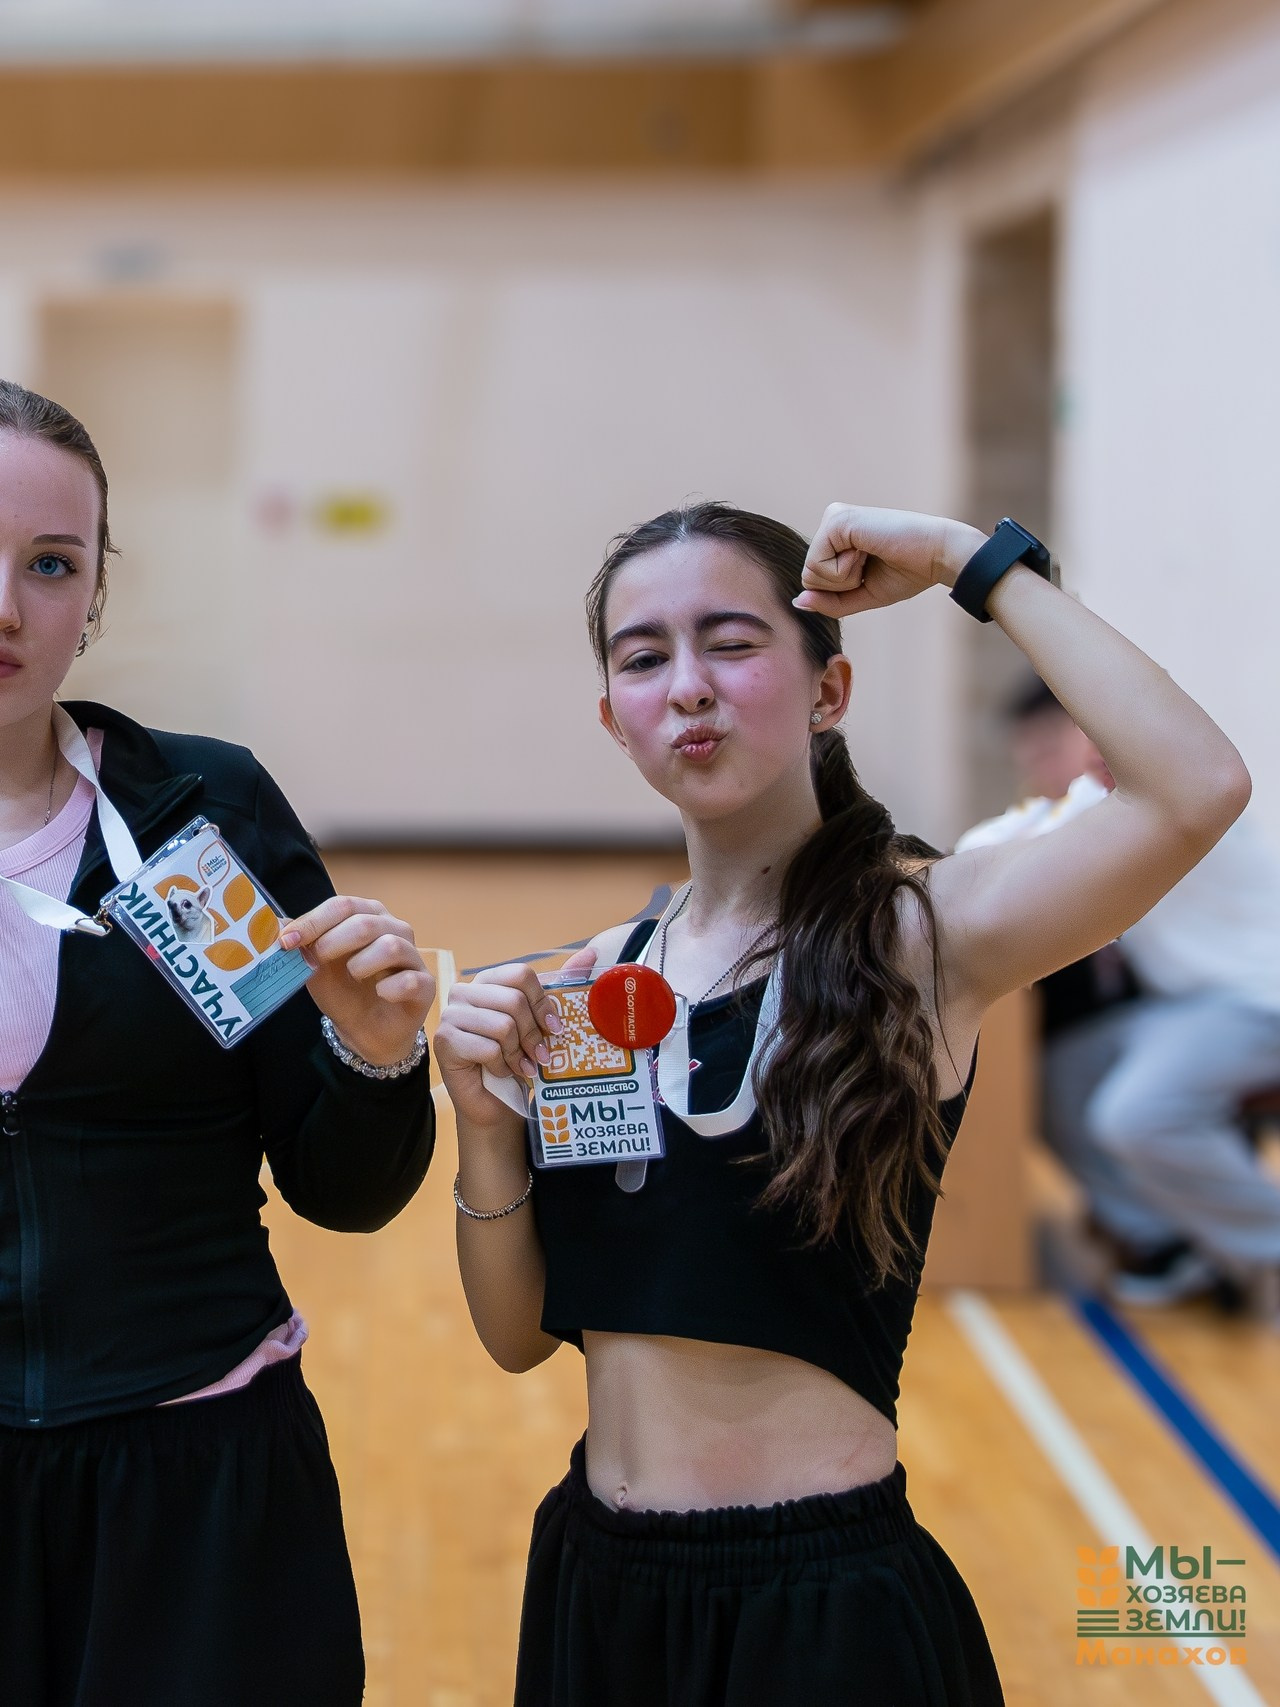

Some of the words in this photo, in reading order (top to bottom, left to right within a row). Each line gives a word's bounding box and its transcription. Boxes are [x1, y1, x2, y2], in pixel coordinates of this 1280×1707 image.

[118, 882, 243, 1039] УЧАСТНИК
[627, 994, 636, 1042] СОГЛАСИЕ
[545, 1088, 573, 1098] НАШЕ
[573, 1082, 636, 1095] СООБЩЕСТВО
[574, 1122, 649, 1139] ХОЗЯЕВА
[576, 1137, 651, 1156] ЗЕМЛИ!
